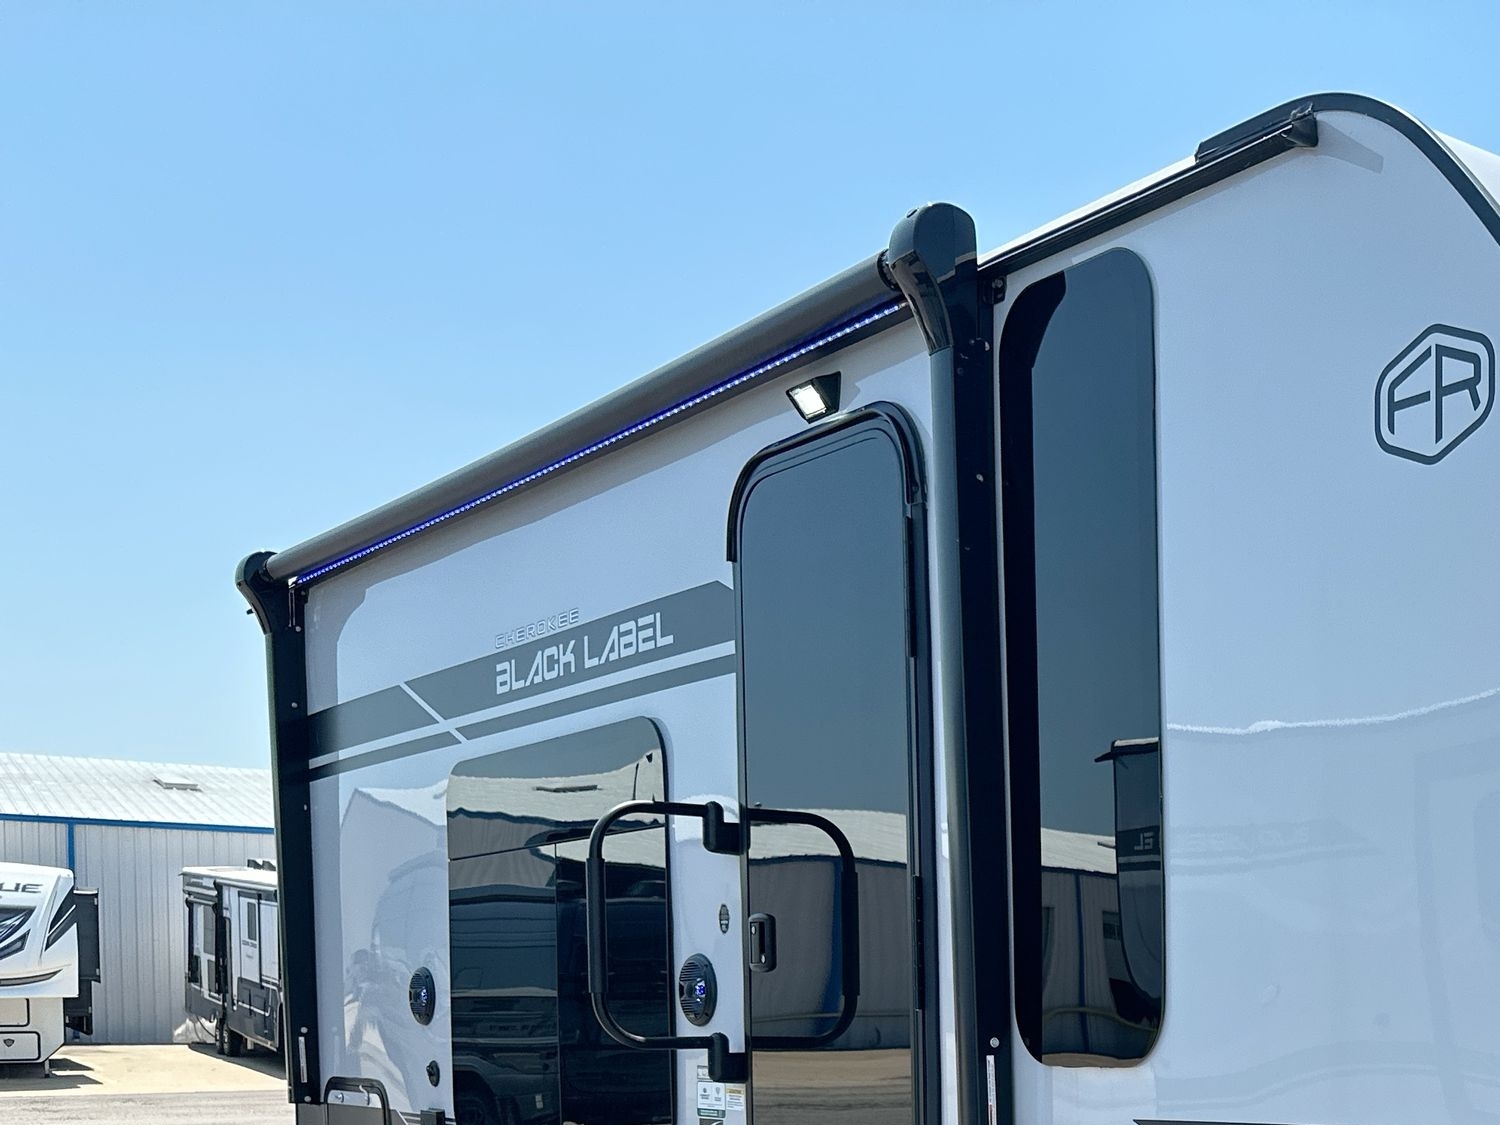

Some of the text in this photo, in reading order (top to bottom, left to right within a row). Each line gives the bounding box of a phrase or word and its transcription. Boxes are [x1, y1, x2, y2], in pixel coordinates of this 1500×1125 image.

[494, 607, 580, 649] CHEROKEE
[495, 611, 674, 695] BLACK LABEL
